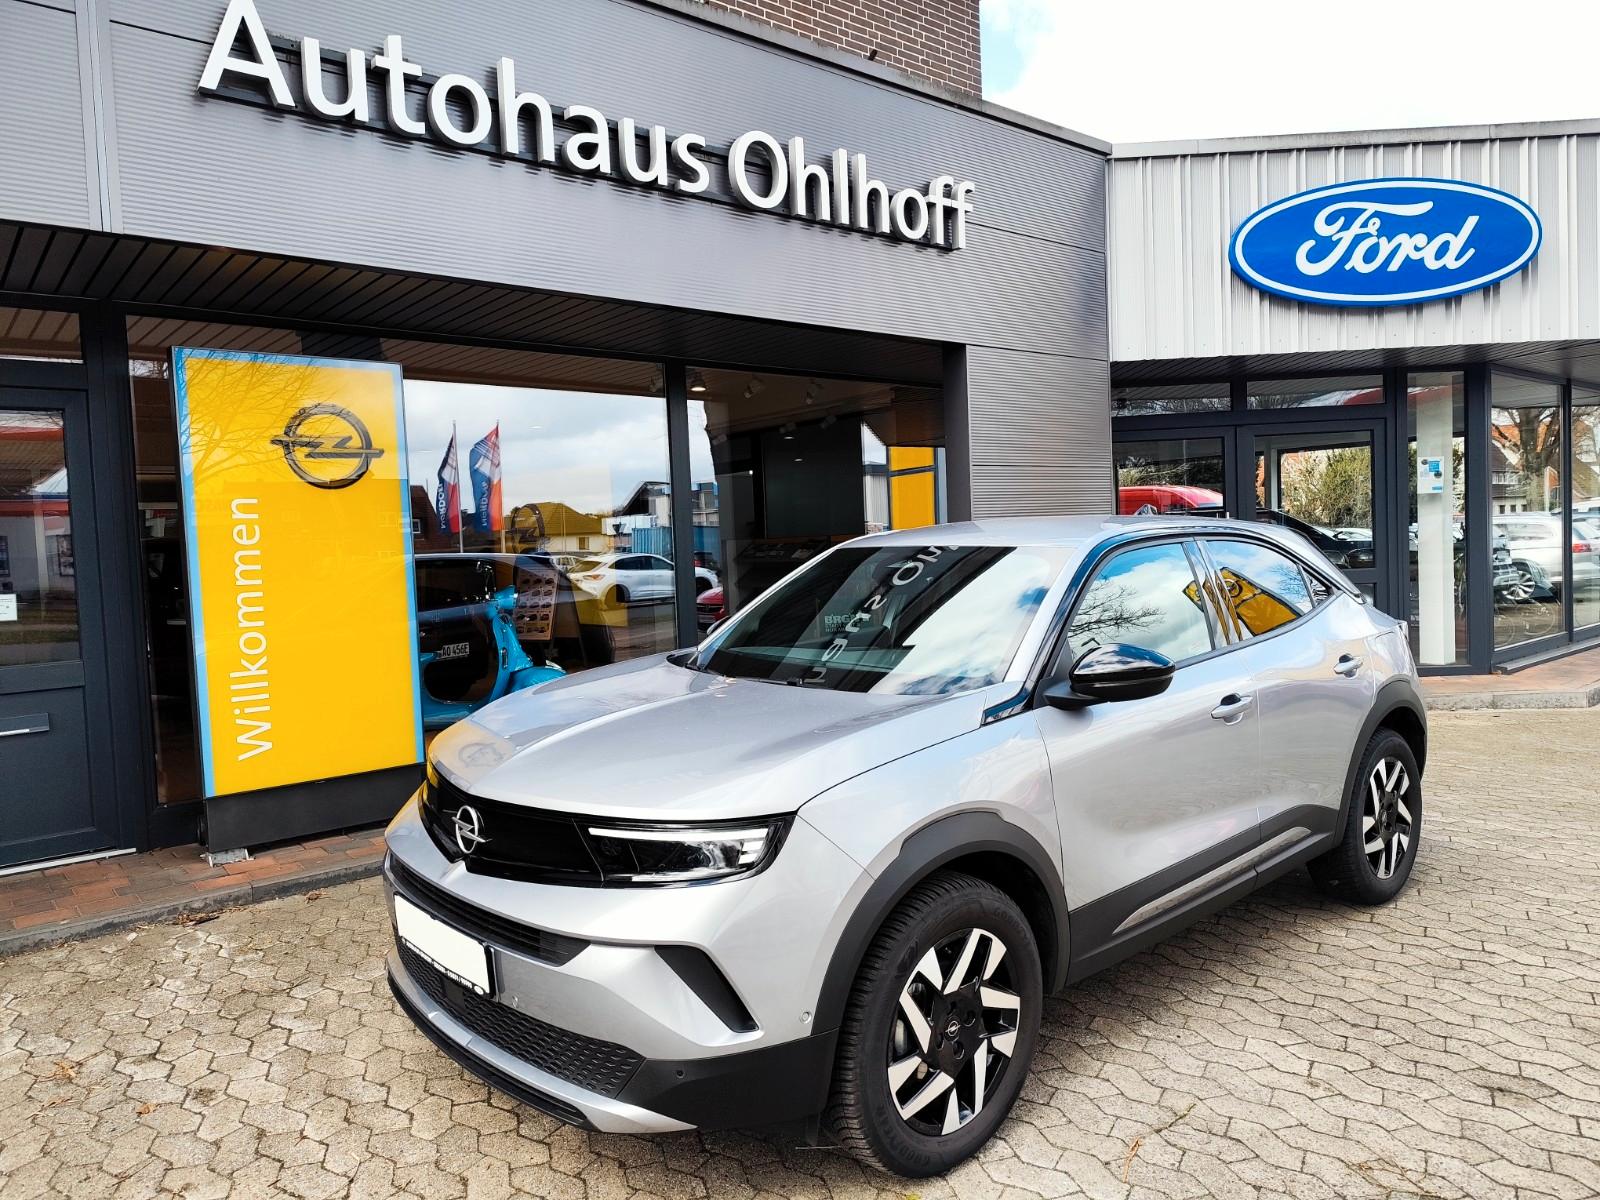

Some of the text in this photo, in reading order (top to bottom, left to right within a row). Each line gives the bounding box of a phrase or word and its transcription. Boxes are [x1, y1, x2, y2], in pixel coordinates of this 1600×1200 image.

[198, 0, 976, 249] Autohaus Ohlhoff
[1295, 200, 1480, 277] Ford
[229, 498, 273, 762] Willkommen
